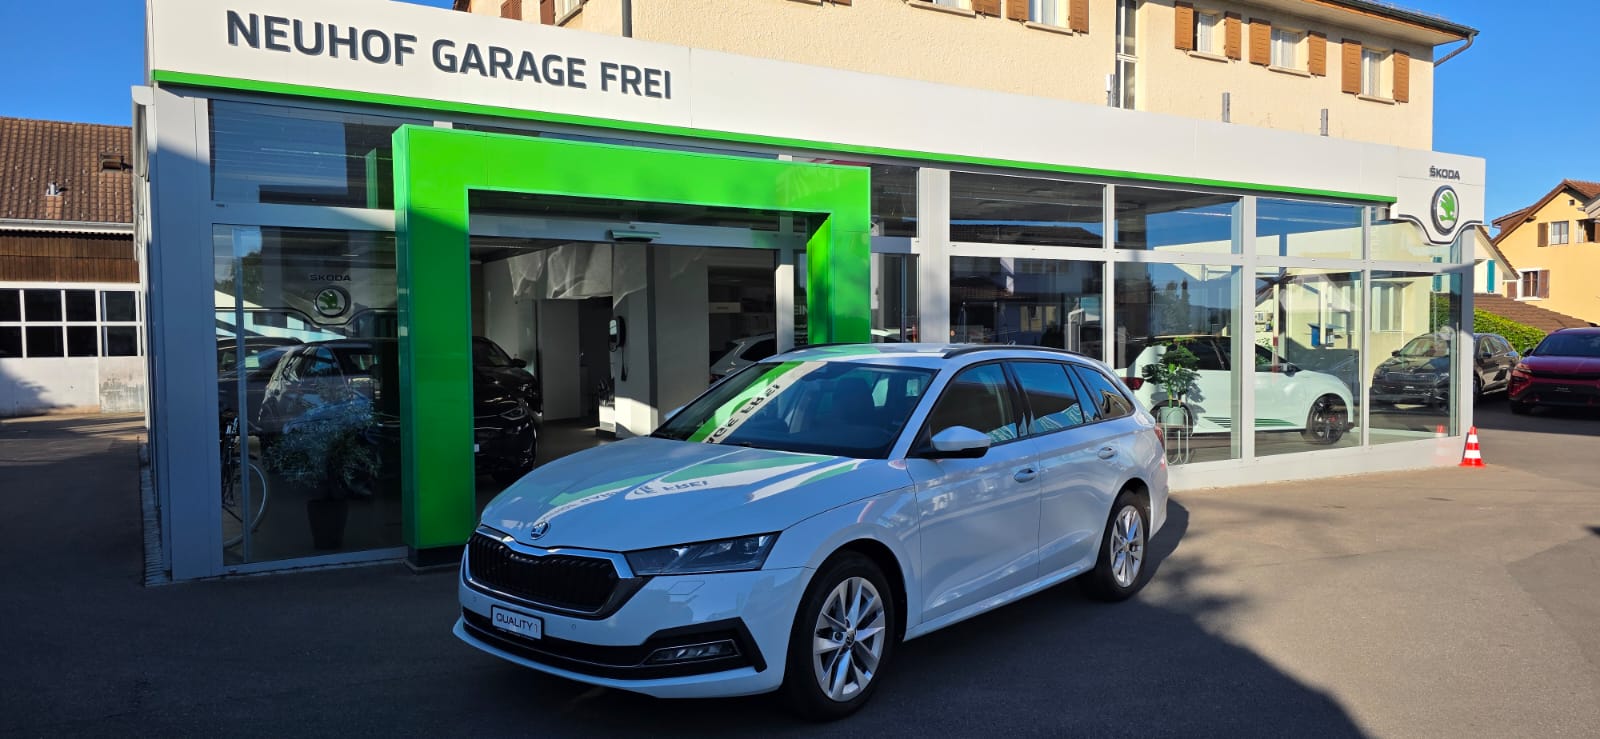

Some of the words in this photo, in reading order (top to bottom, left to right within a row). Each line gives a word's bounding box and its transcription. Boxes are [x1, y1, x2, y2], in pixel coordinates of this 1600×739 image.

[226, 9, 417, 66] NEUHOF
[431, 39, 587, 90] GARAGE
[600, 61, 672, 100] FREI
[1429, 165, 1461, 180] ŠKODA
[496, 612, 533, 631] QUALITY
